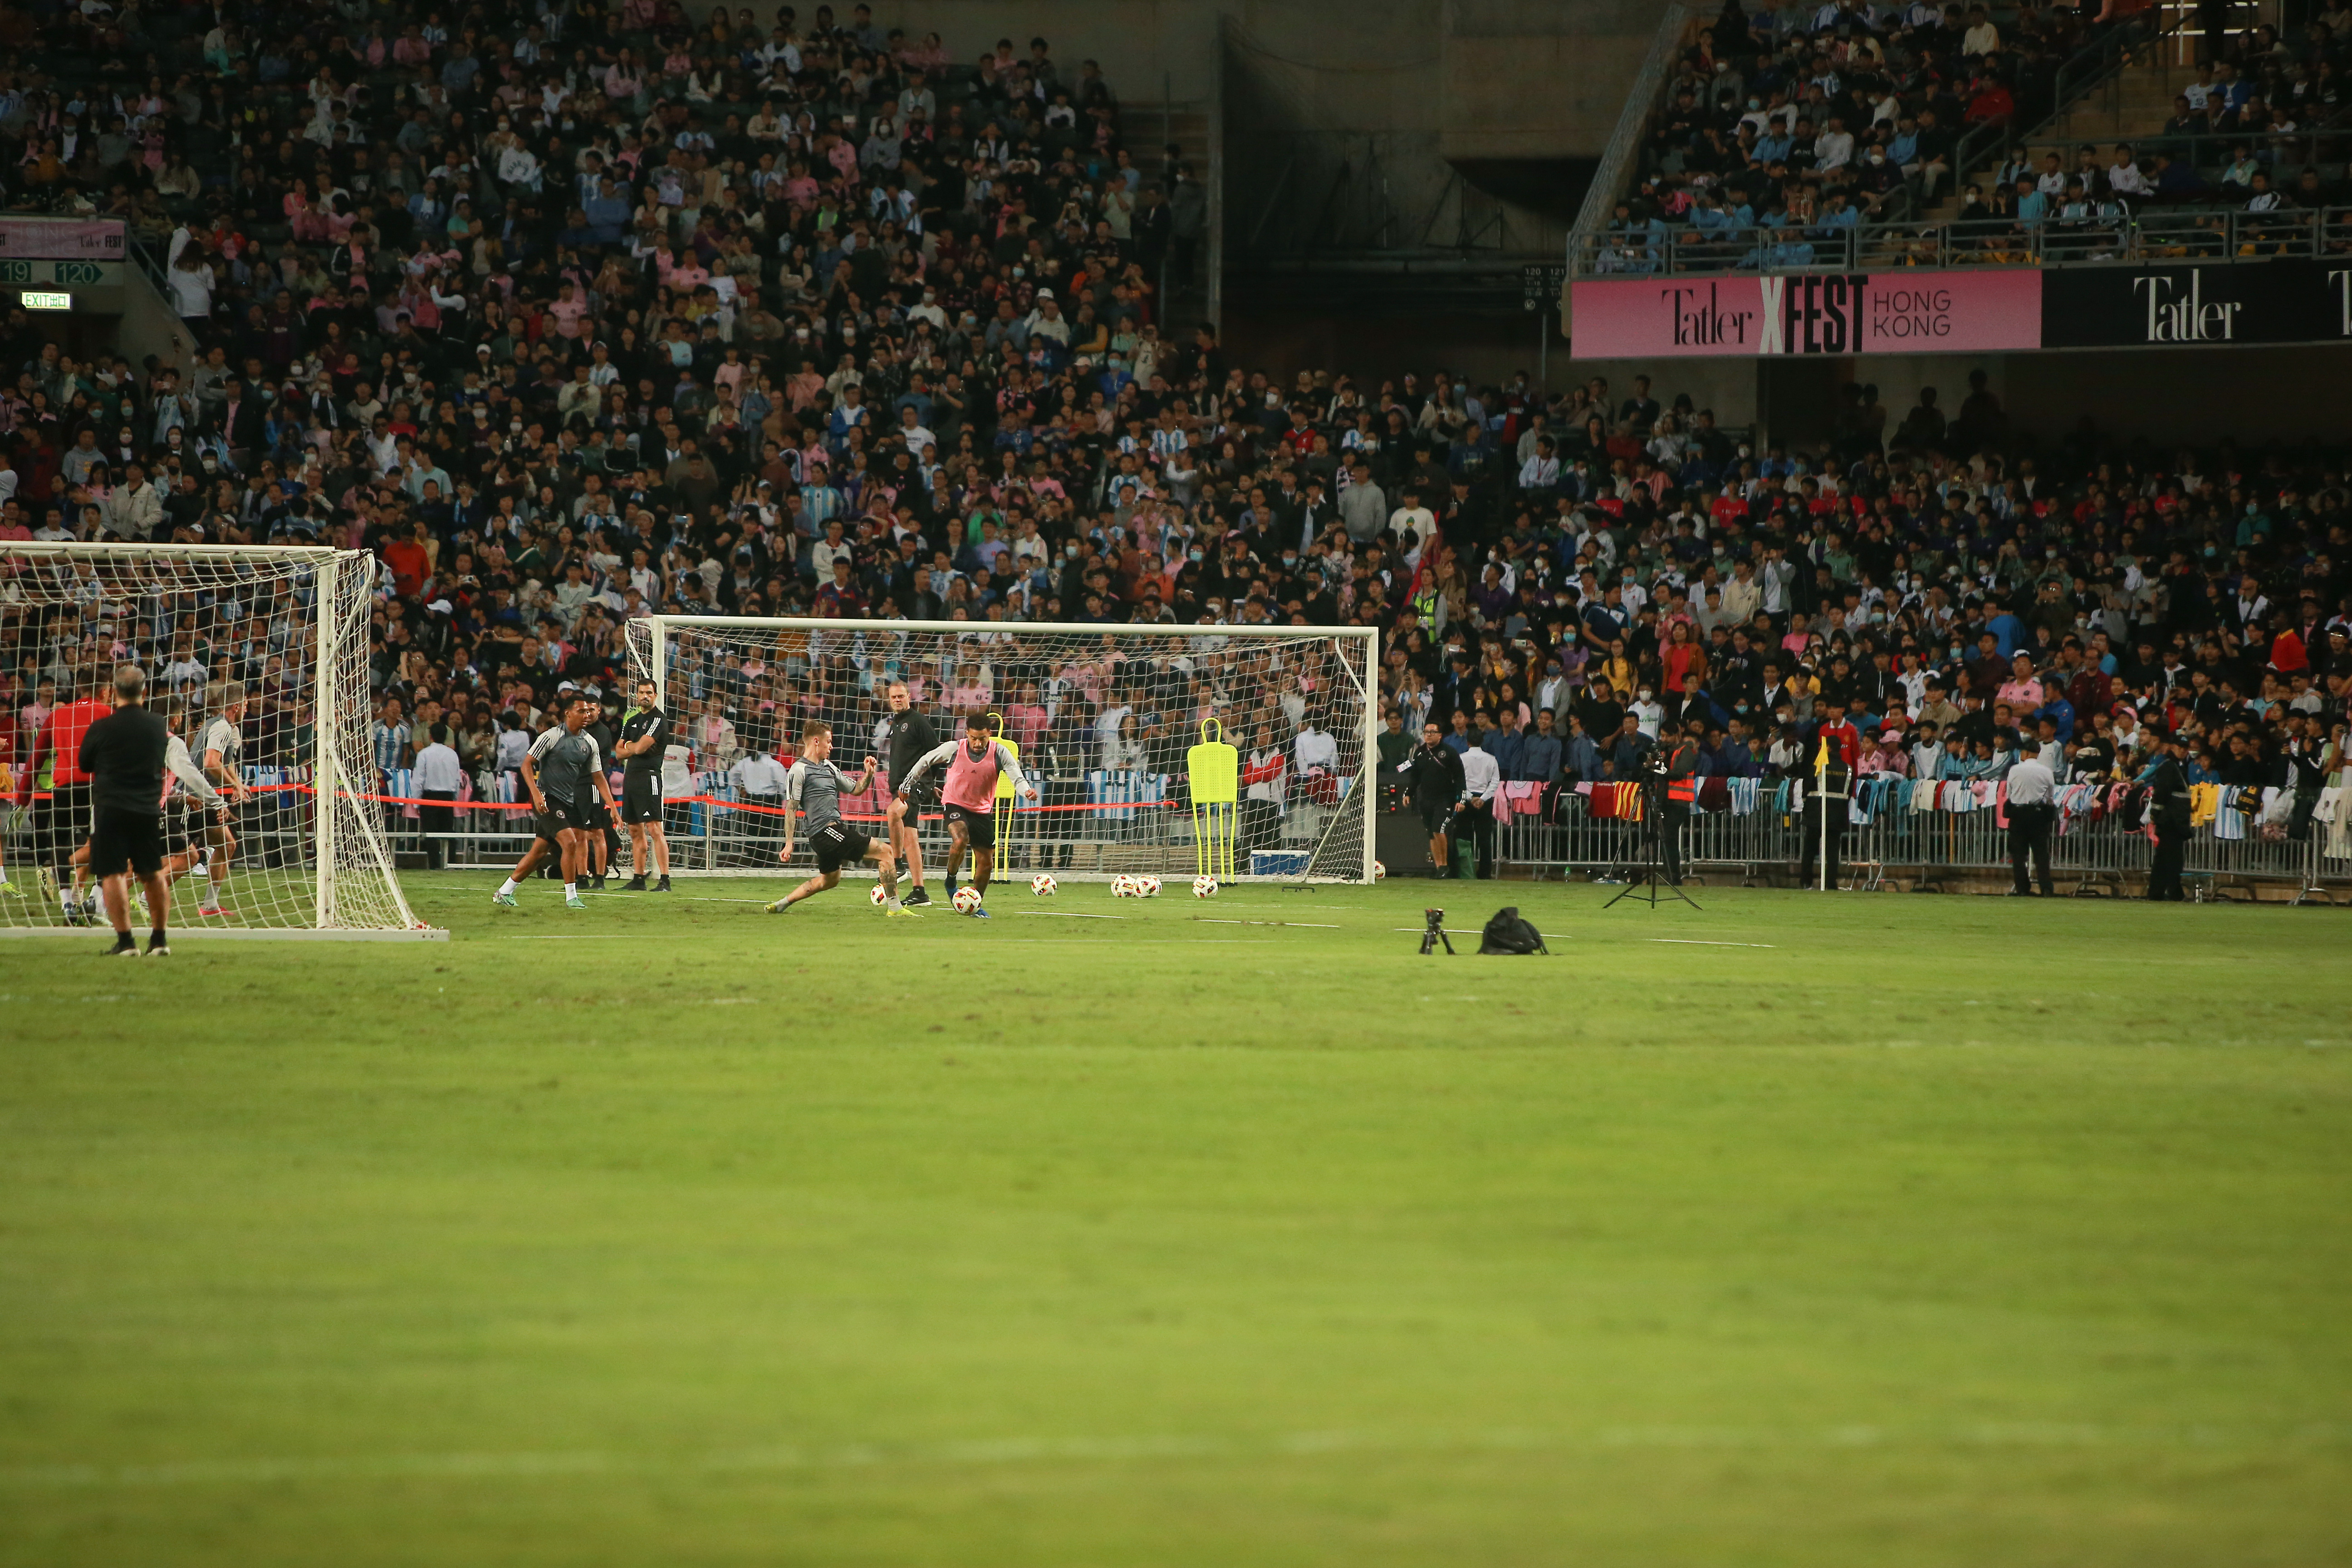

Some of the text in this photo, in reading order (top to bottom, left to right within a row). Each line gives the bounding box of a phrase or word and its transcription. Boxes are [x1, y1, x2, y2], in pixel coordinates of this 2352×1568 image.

[105, 235, 122, 248] FEST
[59, 263, 93, 284] 120
[1525, 267, 1541, 276] 120
[1873, 290, 1951, 313] HONG
[2134, 269, 2241, 341] Tatler
[1661, 281, 1753, 346] Tatler
[1873, 314, 1951, 338] KONG
[1045, 693, 1062, 703] Jeep
